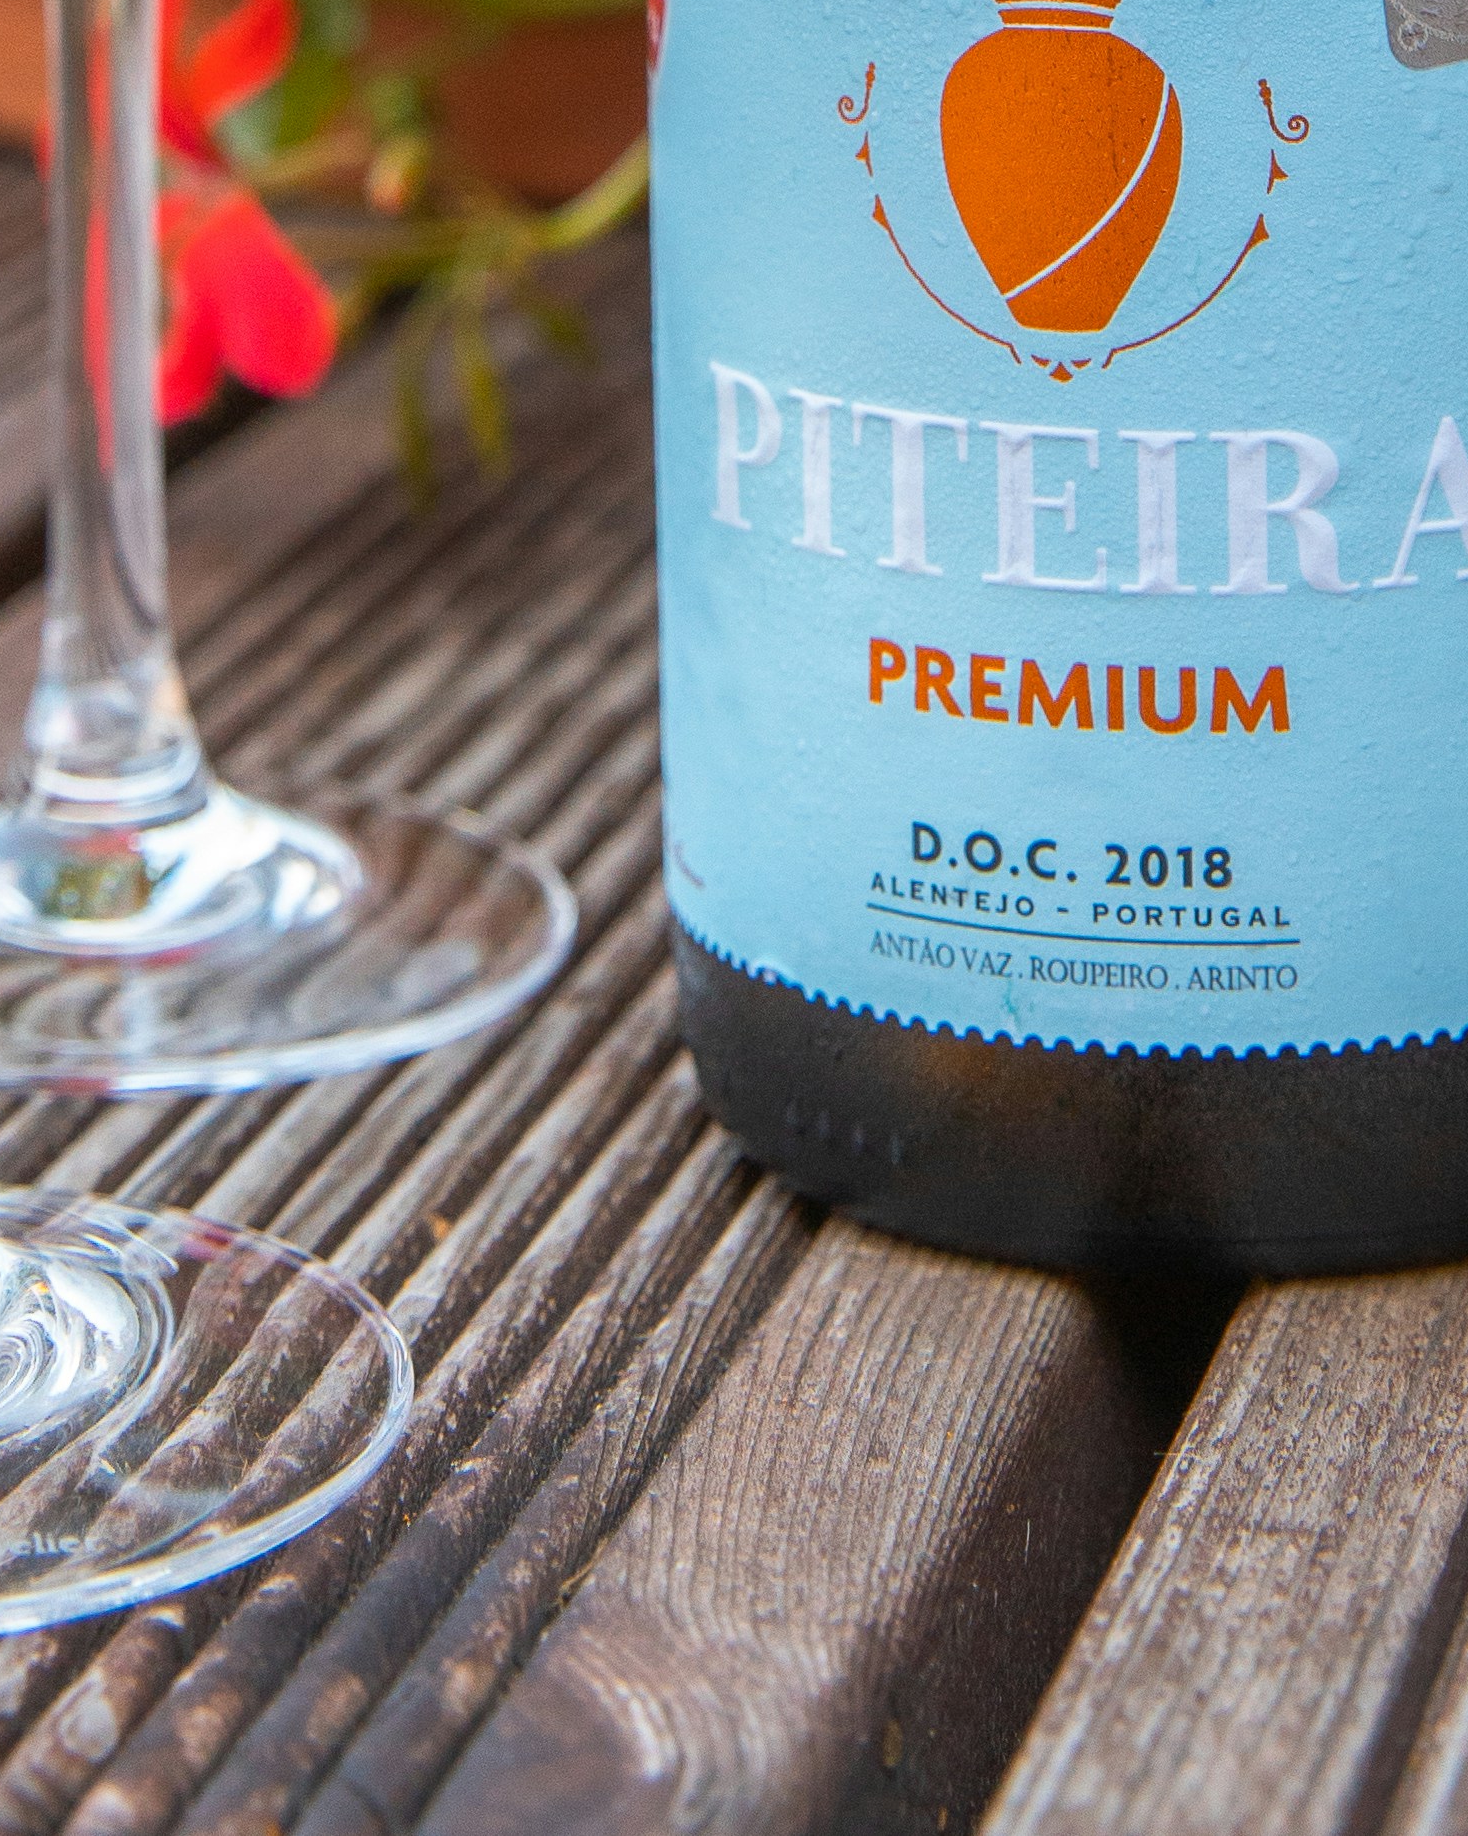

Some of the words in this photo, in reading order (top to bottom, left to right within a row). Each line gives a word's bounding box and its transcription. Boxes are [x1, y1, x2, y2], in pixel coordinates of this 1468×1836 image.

[868, 636, 1291, 733] PREMIUM
[911, 821, 1078, 884] D.O.C.
[1104, 843, 1233, 890] 2018
[871, 872, 1036, 917] ALENTEJO
[1092, 902, 1291, 928] PORTUGAL
[1030, 956, 1169, 991] ROUPEIRO
[1187, 963, 1299, 992] ARINTO
